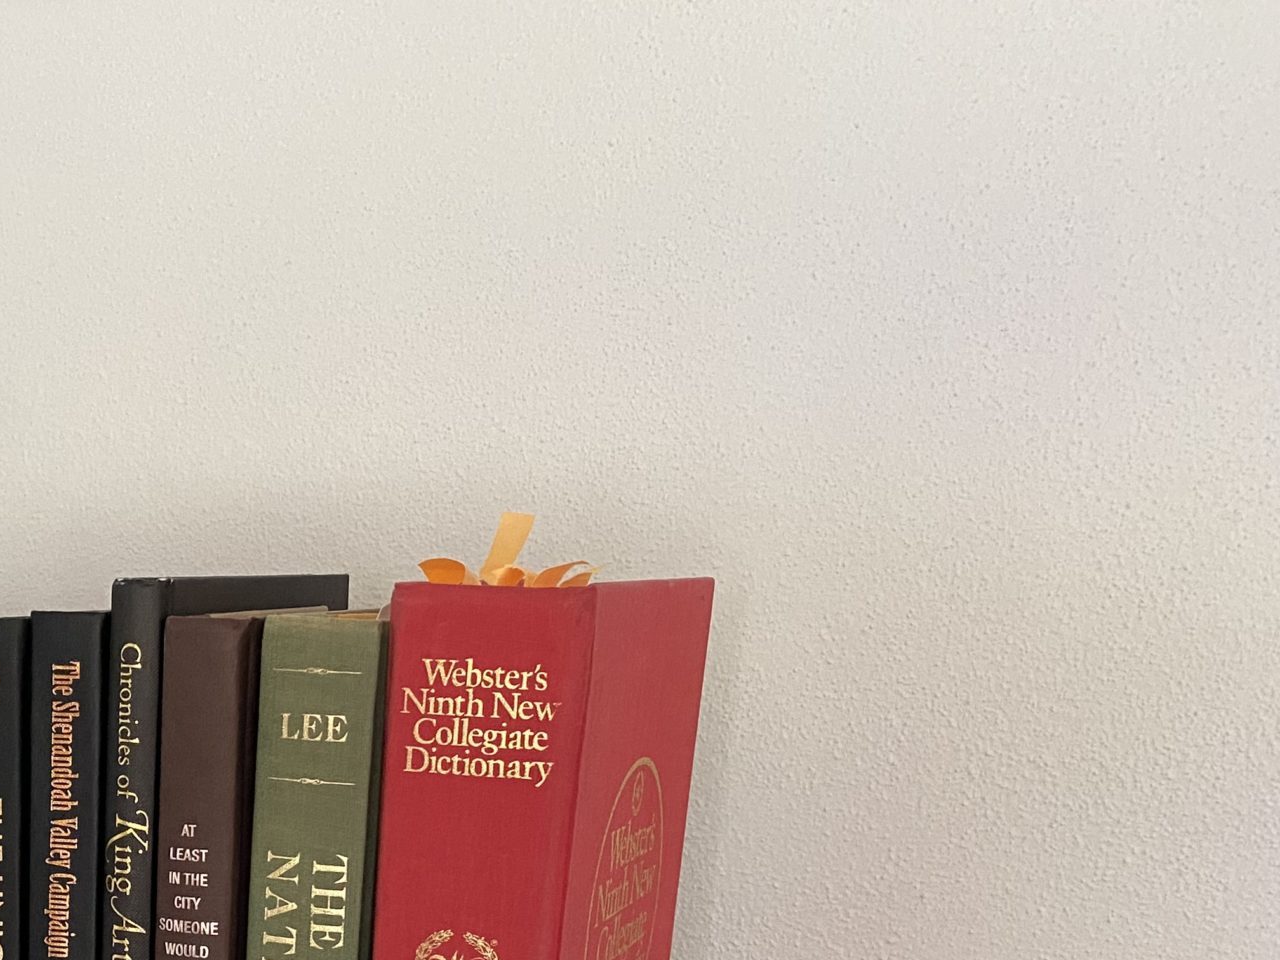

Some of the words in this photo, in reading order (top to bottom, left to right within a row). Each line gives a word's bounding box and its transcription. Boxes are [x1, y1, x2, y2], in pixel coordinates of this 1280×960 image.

[51, 660, 81, 696] The
[422, 658, 548, 691] Webster's
[117, 642, 142, 766] Chronicles
[400, 687, 484, 718] Ninth
[492, 691, 562, 722] New
[280, 713, 349, 742] LEE
[413, 717, 549, 755] Collegiate
[50, 701, 80, 812] Shenandoah
[403, 746, 554, 788] Dictionary
[117, 775, 138, 804] of
[45, 816, 79, 869] Valley
[181, 824, 197, 838] AT
[106, 809, 150, 895] King
[170, 847, 208, 863] LEAST
[169, 871, 181, 886] IN
[183, 872, 209, 888] THE
[44, 873, 77, 958] Campaign
[174, 896, 201, 911] CITY
[309, 854, 348, 950] THE
[159, 918, 219, 936] SOMEONE
[165, 942, 209, 959] WOULD
